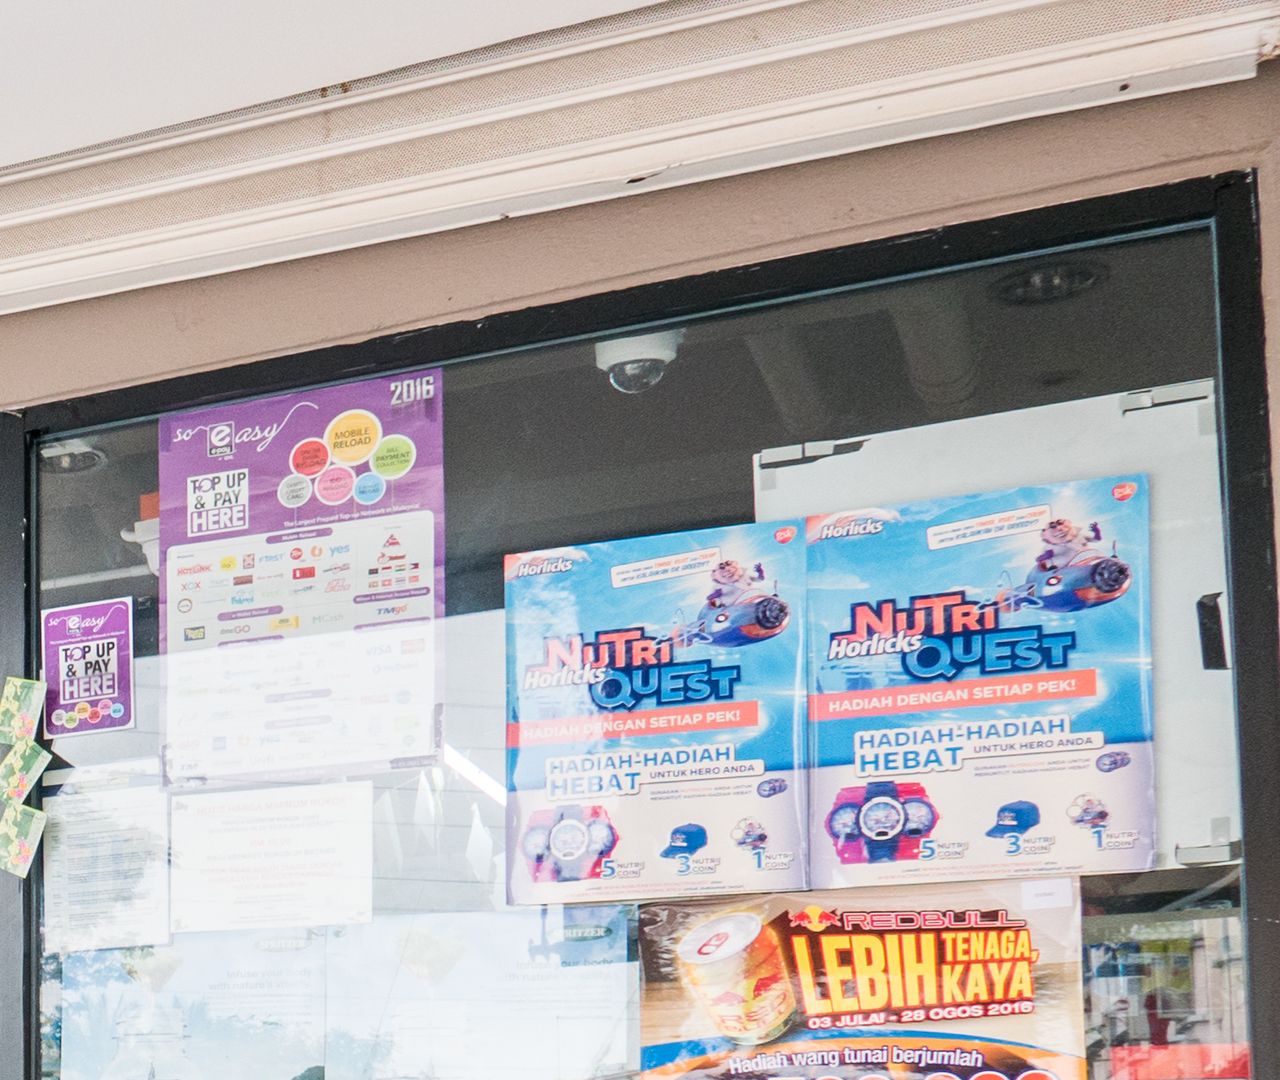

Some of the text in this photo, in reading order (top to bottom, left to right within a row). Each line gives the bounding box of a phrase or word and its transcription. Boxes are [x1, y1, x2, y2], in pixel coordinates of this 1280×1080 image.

[389, 376, 435, 406] 2016
[333, 436, 372, 449] RELOAD
[334, 426, 371, 440] MOBILE
[376, 450, 410, 463] PAYMENT
[191, 471, 247, 496] TOP UP
[194, 490, 241, 510] & PAY
[192, 506, 245, 533] HERE
[820, 519, 884, 540] Horlicks
[329, 544, 350, 557] yes
[517, 558, 573, 577] Horlicks
[63, 642, 115, 662] TOP UP
[827, 632, 922, 660] Horlicks
[66, 659, 111, 678] & PAY
[524, 665, 606, 691] Horlicks
[64, 673, 115, 700] HERE
[829, 679, 1076, 713] HADIAH DENGAN SETIAP PEK!
[524, 709, 741, 741] HADIAH DENGAN SETIAP PEK!
[859, 718, 1067, 749] HADIAH-HADIAH
[549, 746, 732, 776] HADIAH-HADIAH
[860, 736, 1094, 773] HEBAT UNTUK HERO ANDA
[549, 763, 756, 798] HEBAT UNTUK HERO ANDA
[919, 838, 935, 860] 5
[1005, 834, 1021, 857] 3
[1092, 828, 1105, 849] 1
[602, 859, 616, 879] 5
[675, 853, 690, 875] 3
[752, 849, 765, 869] 1
[942, 929, 1039, 963] TENAGA,
[794, 933, 941, 1014] LEBIH
[943, 964, 1035, 1004] KAYA
[808, 1016, 832, 1030] 03
[835, 1013, 886, 1028] JULAI
[900, 1009, 923, 1023] 28
[931, 1006, 984, 1020] OGOS
[987, 1001, 1034, 1016] 2016
[729, 1047, 984, 1074] Hadiah wang tunai berjumlah
